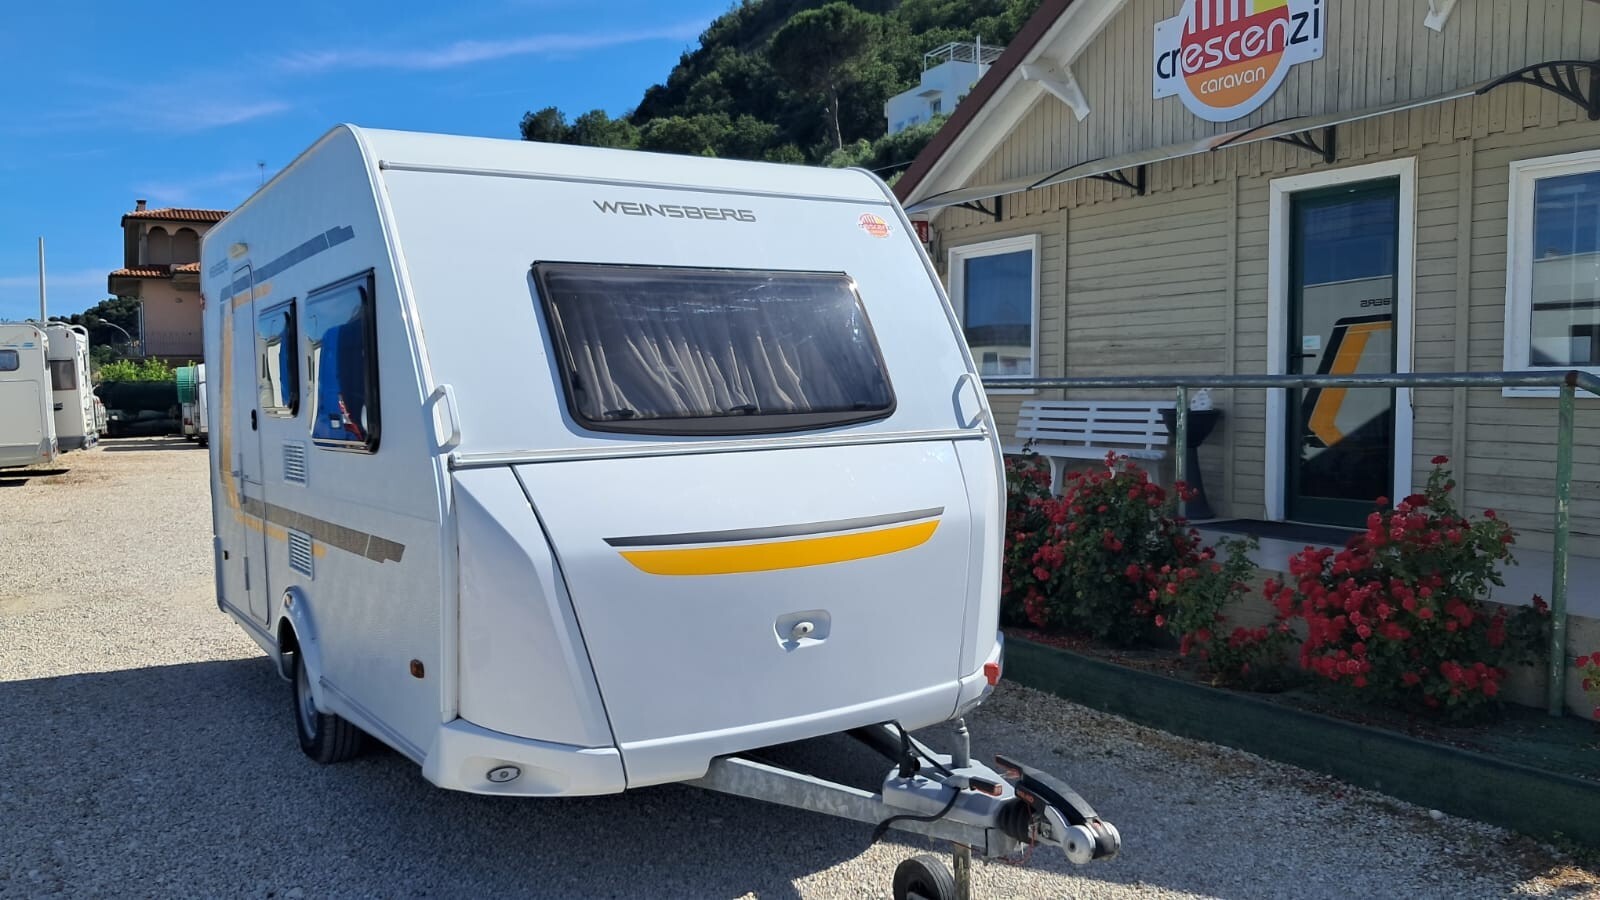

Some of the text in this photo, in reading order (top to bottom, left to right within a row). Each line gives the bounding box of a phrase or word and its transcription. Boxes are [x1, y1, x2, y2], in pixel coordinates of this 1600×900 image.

[1156, 0, 1320, 79] crescenzi
[1200, 66, 1266, 94] caravan
[593, 200, 756, 222] WEINSBERG
